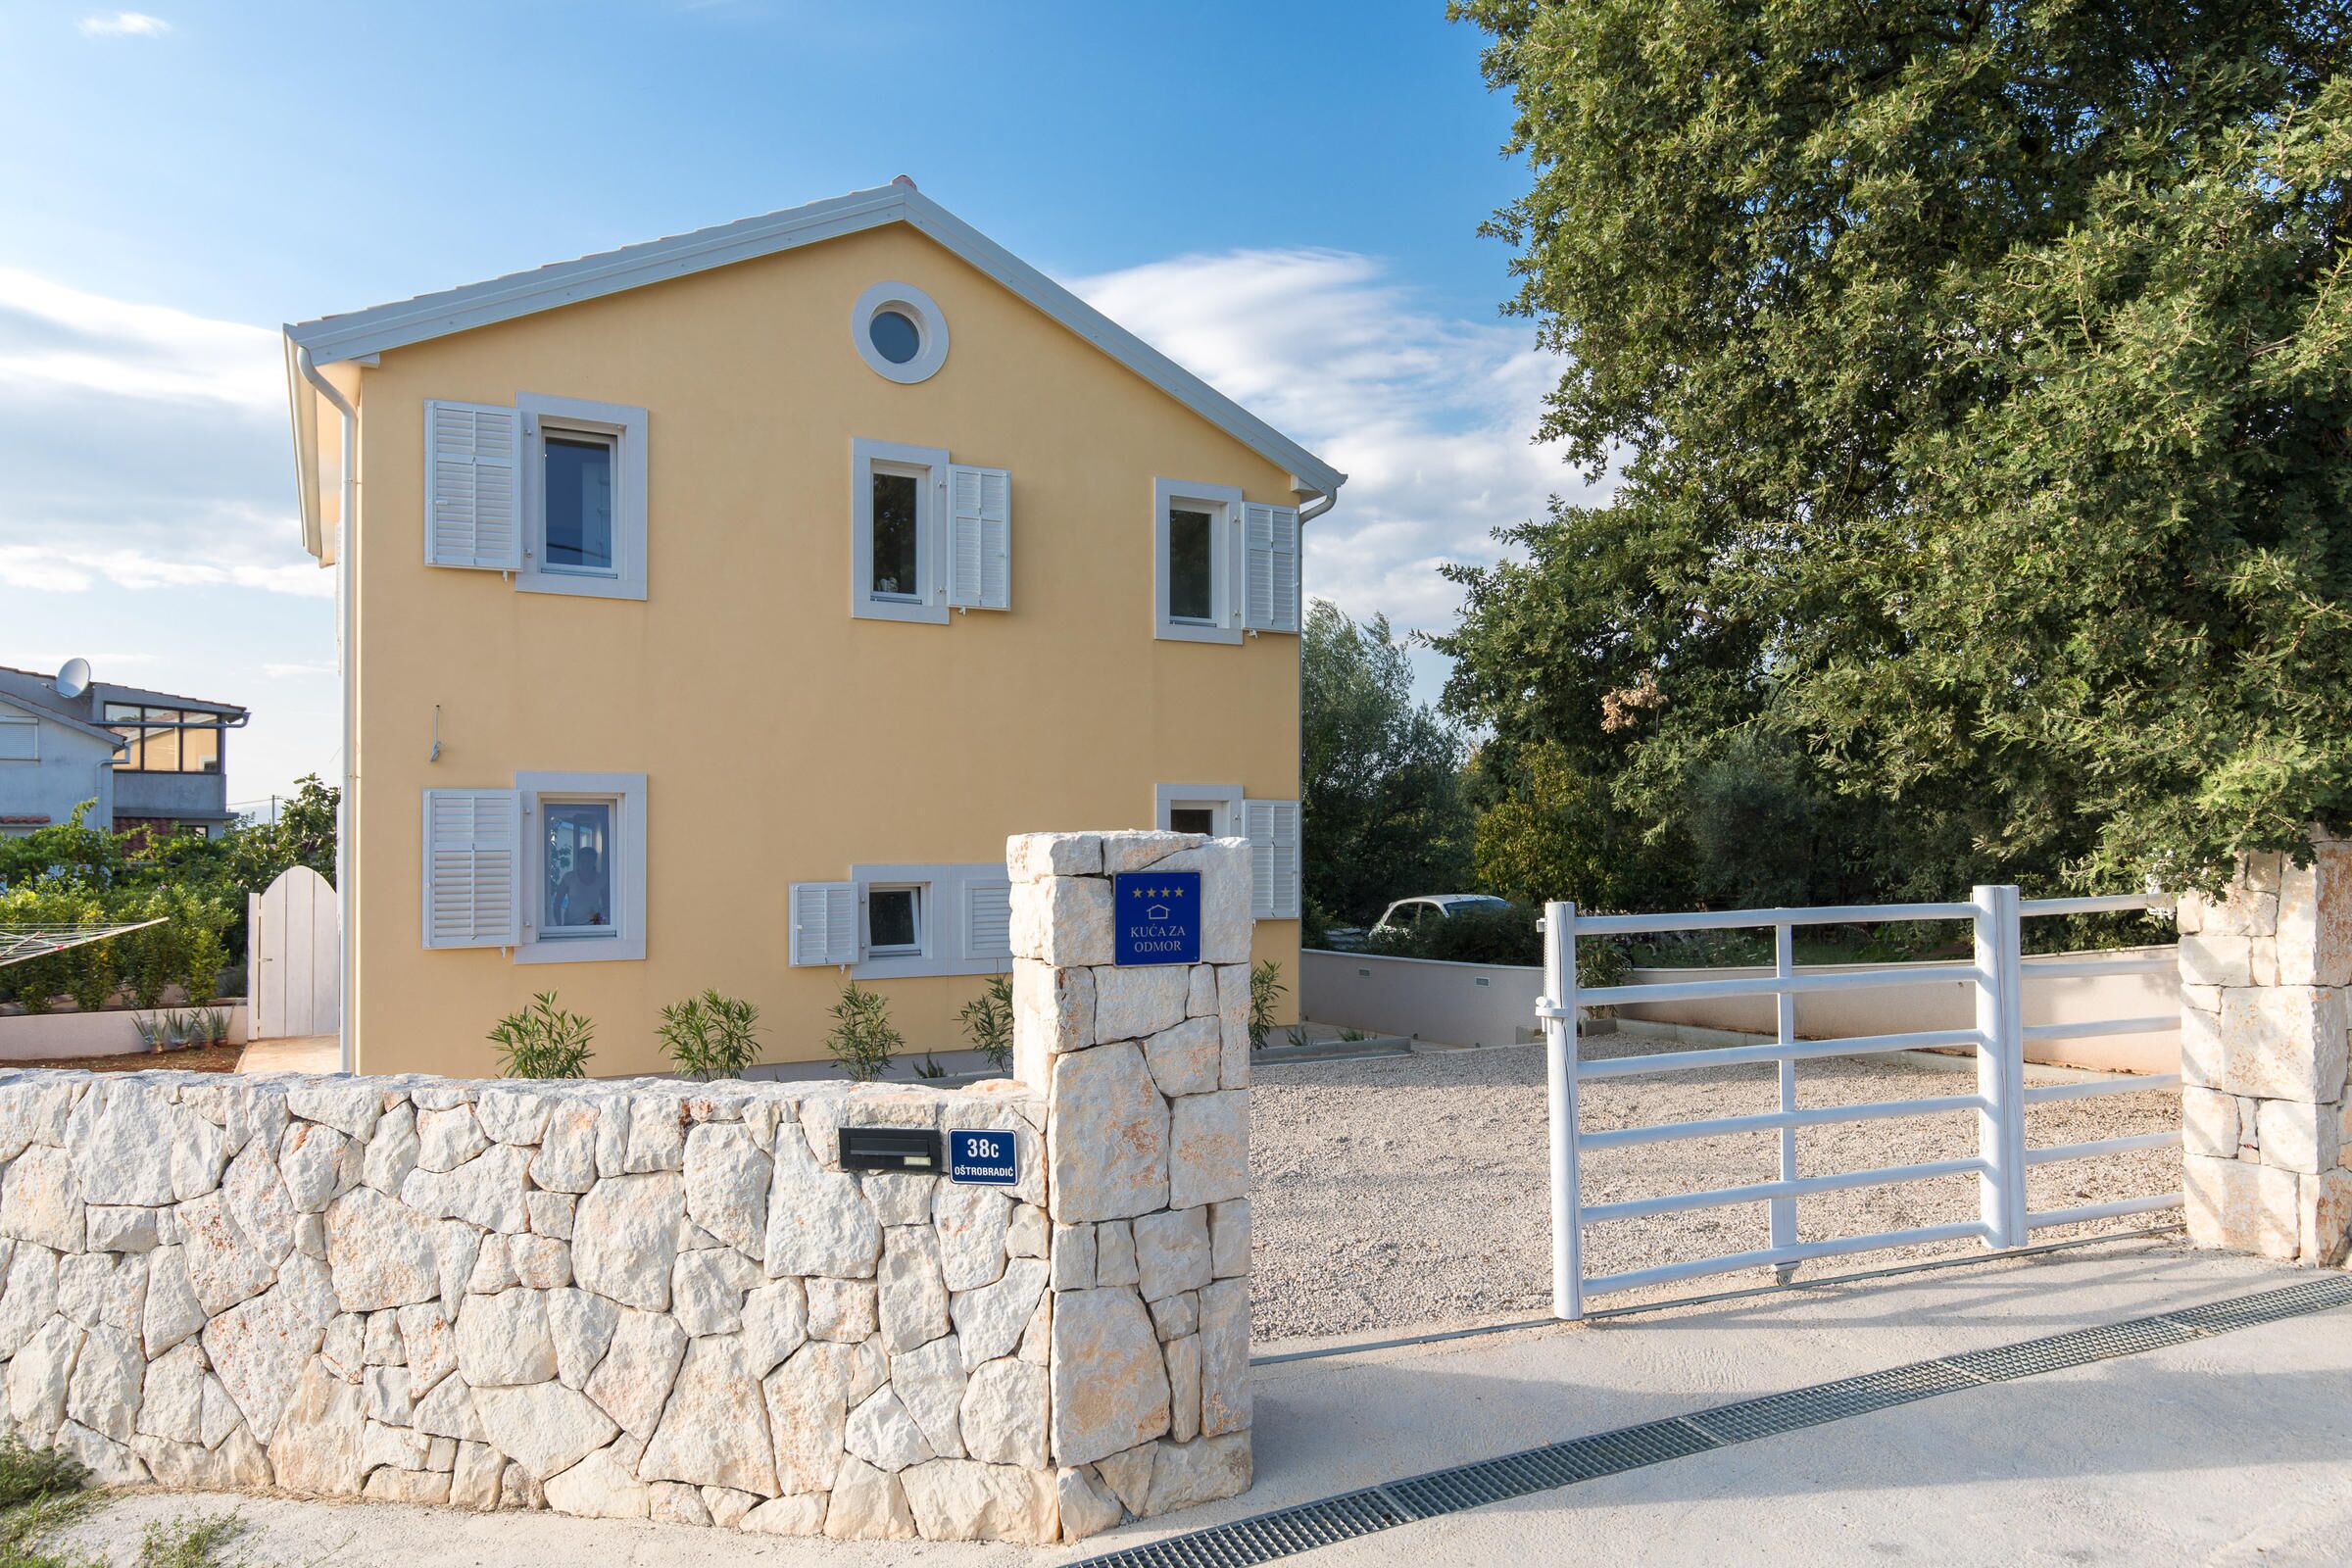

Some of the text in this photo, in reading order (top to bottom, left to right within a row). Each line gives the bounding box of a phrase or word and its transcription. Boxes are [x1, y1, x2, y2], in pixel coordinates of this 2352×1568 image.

[1131, 923, 1186, 937] KUĆA ZA
[1135, 940, 1182, 953] ODMOR
